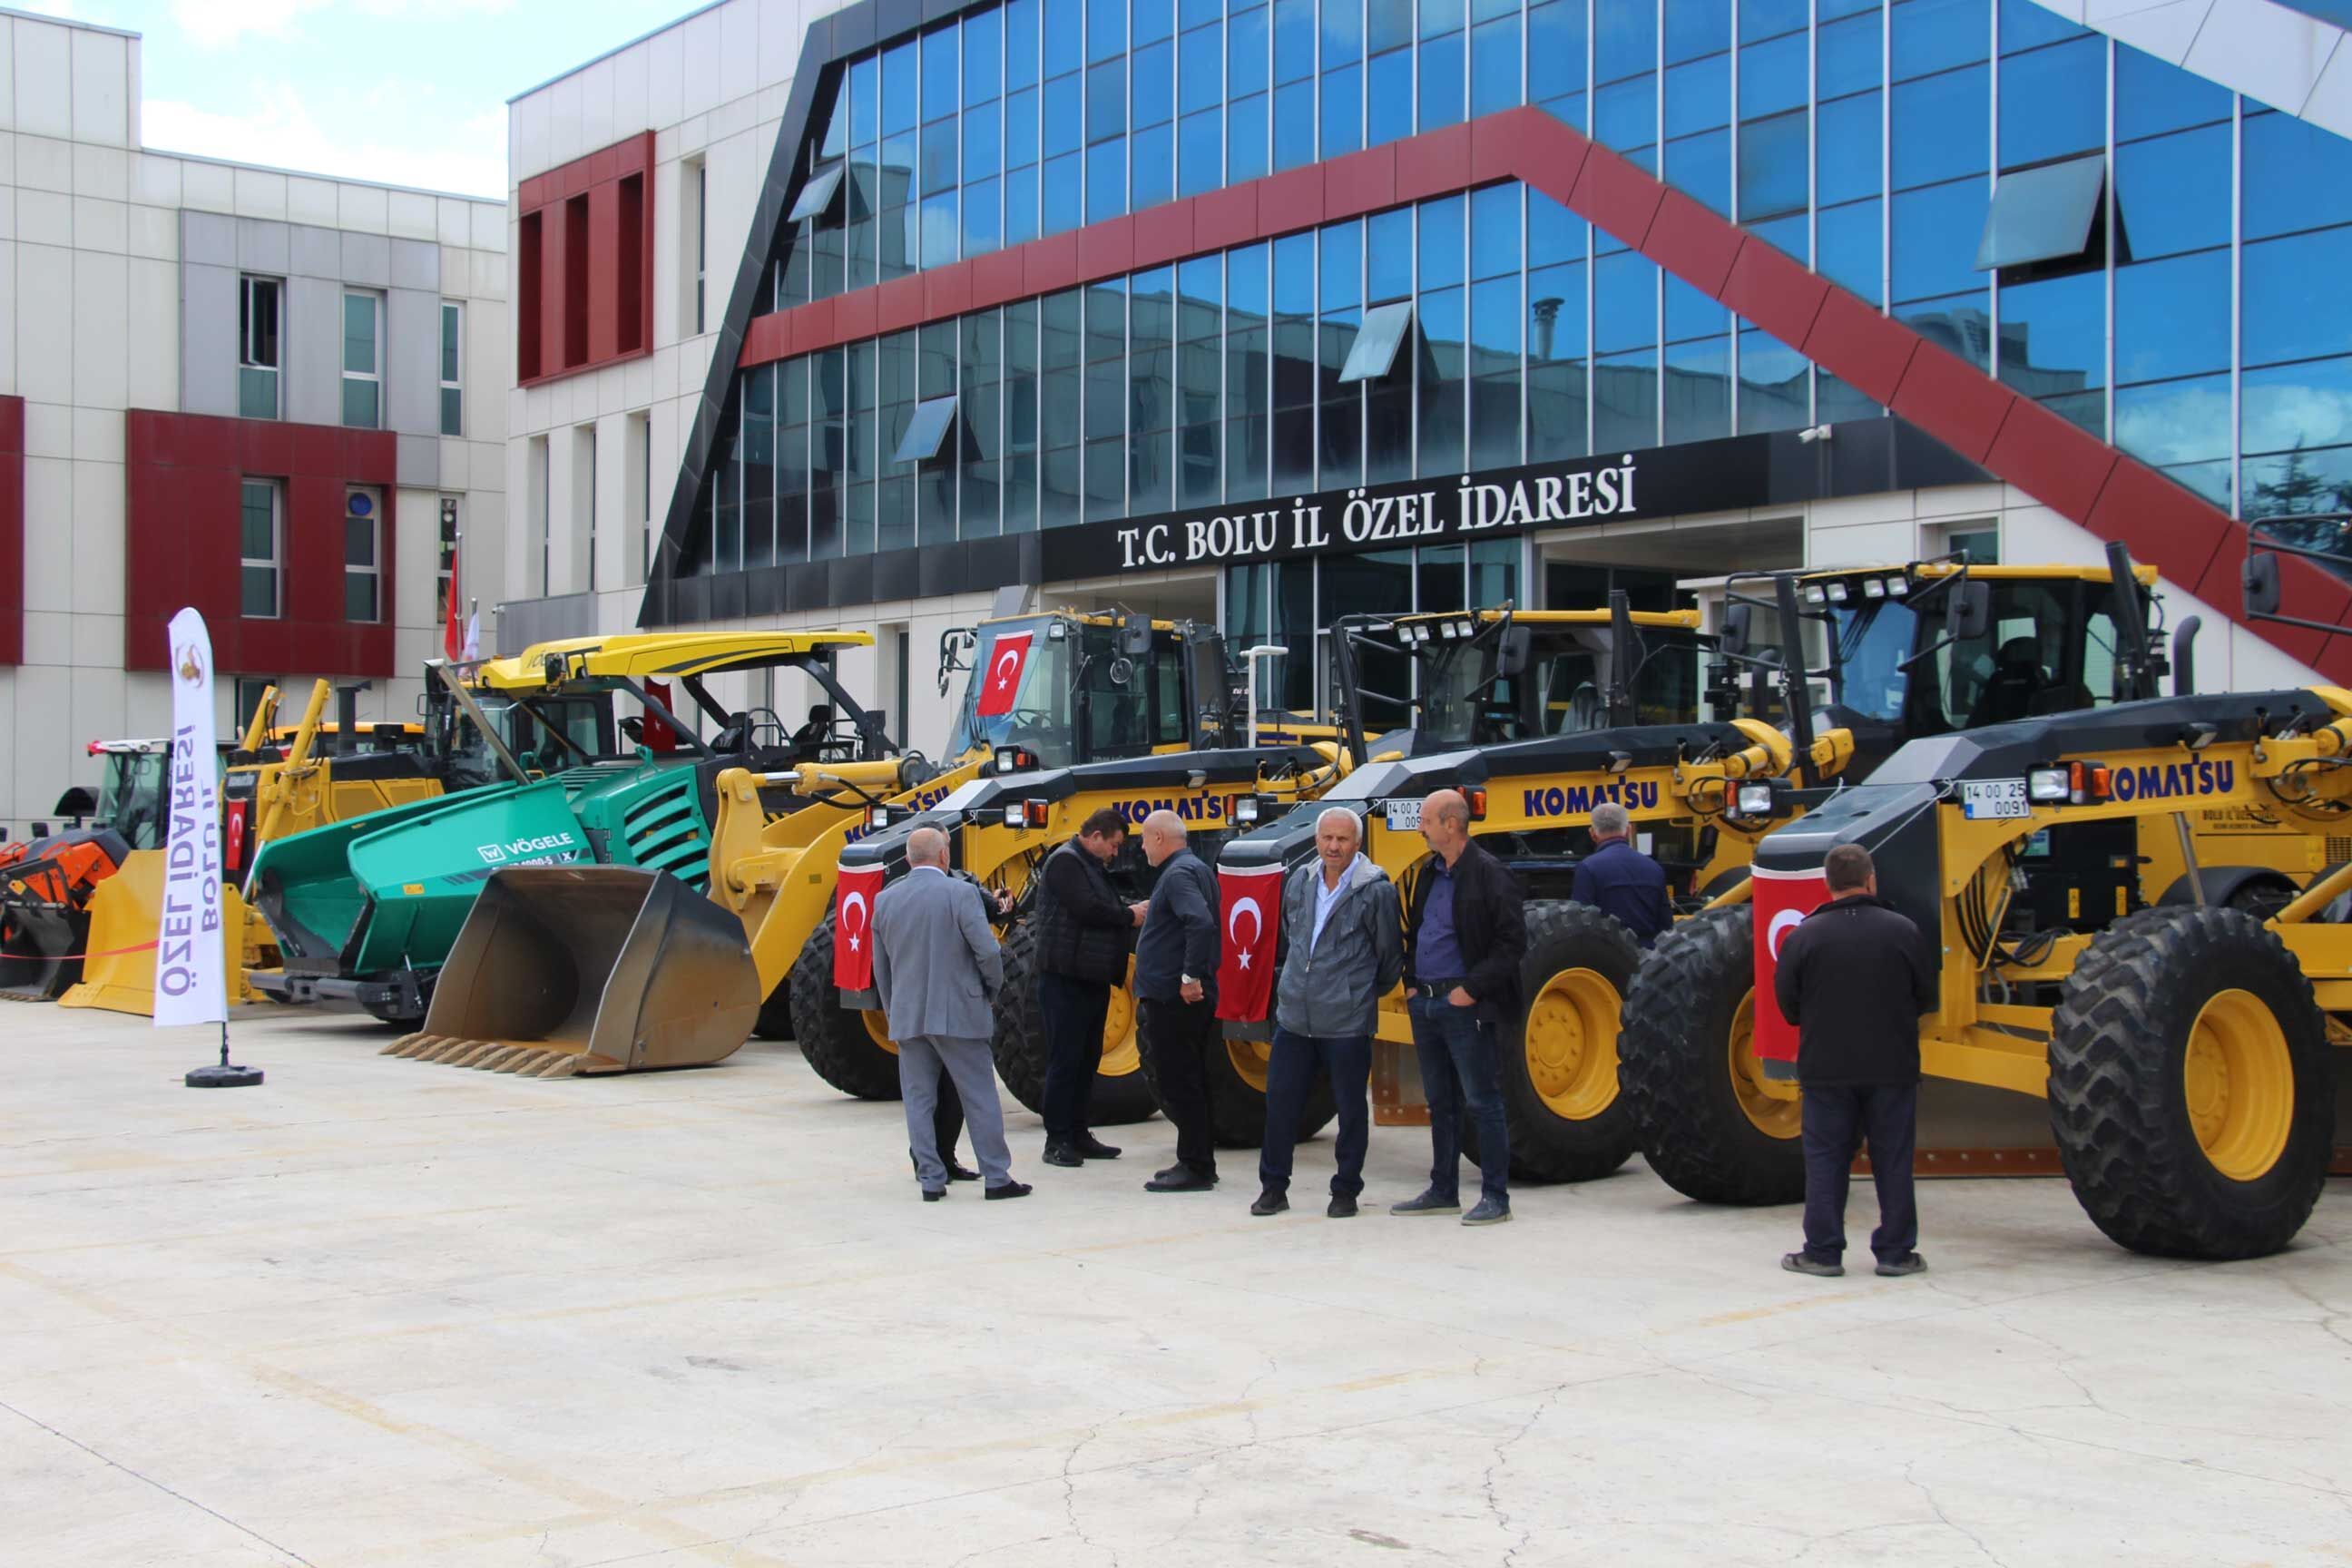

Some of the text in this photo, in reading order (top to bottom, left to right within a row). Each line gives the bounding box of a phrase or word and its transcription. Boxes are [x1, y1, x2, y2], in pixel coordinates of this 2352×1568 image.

[1118, 454, 1637, 568] T.C. BOLU İL ÖZEL İDARESİ
[1524, 775, 1659, 817] KOMATSU
[1967, 786, 1980, 799] 14
[2009, 783, 2026, 798] 25
[1388, 803, 1397, 814] 14
[1994, 800, 2027, 815] 0091
[1406, 817, 1422, 828] 009
[505, 832, 574, 855] VÖGELE
